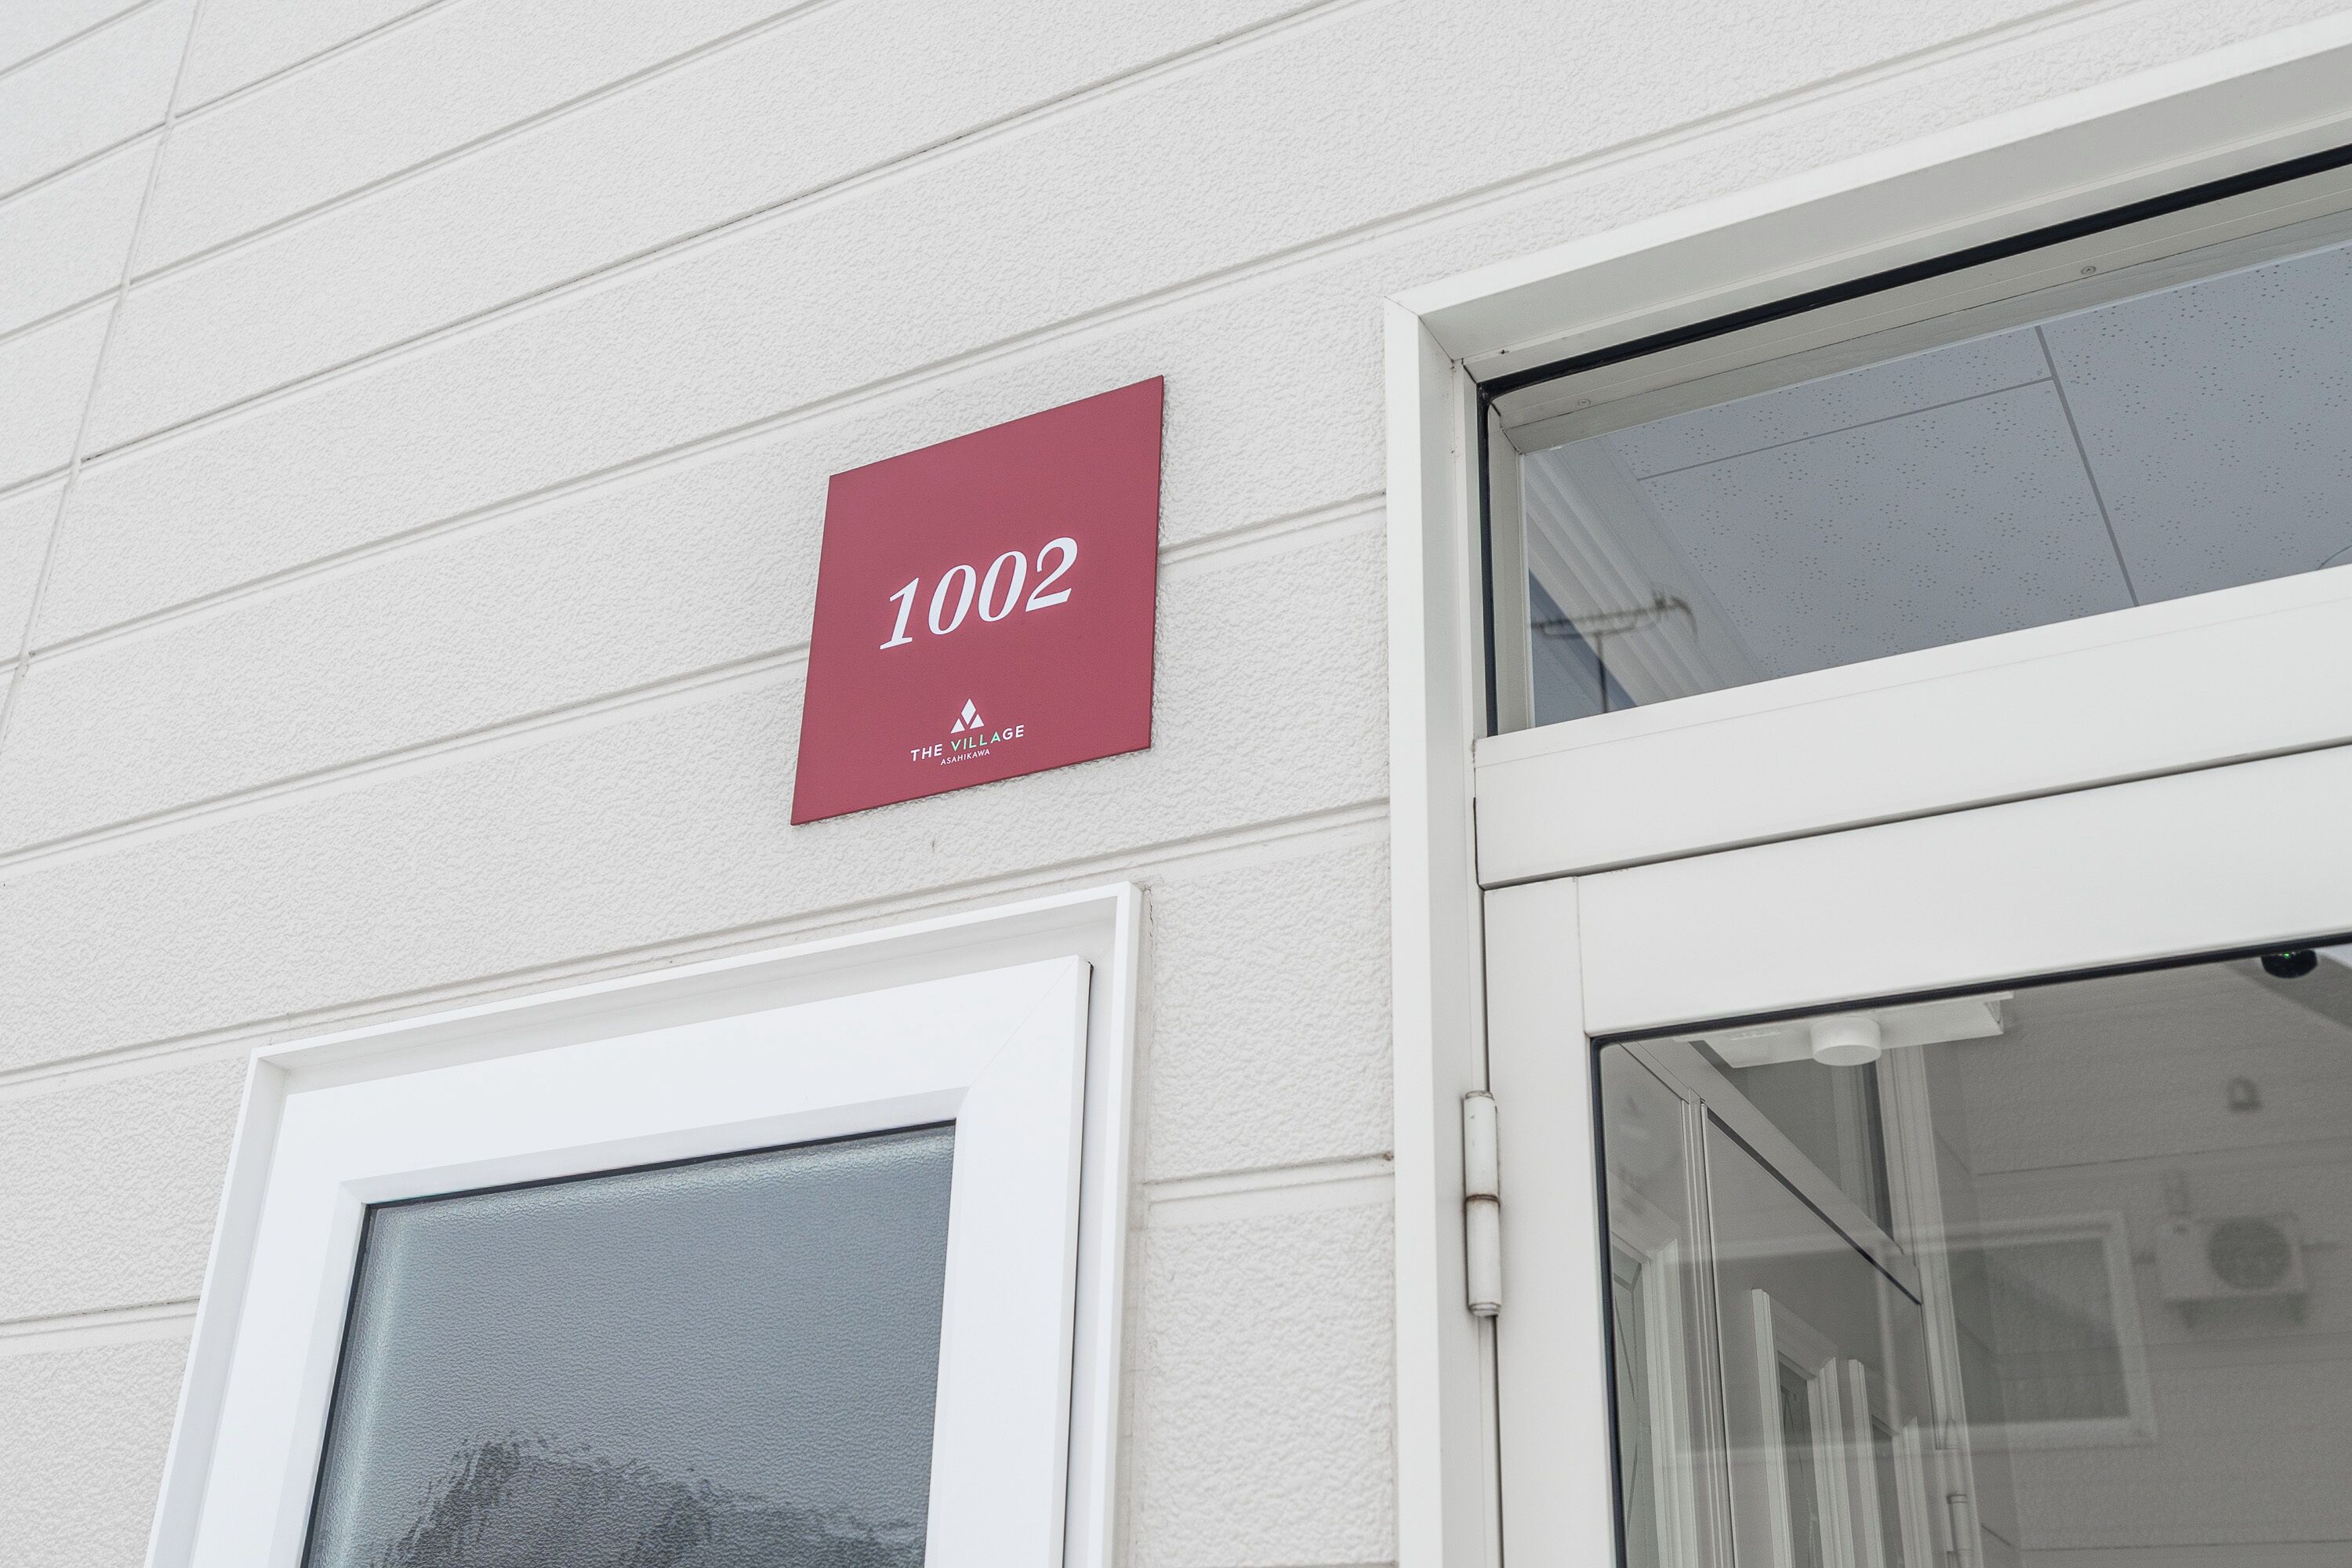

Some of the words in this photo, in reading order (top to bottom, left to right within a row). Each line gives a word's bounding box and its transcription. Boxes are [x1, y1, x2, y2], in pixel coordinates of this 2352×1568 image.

[879, 536, 1078, 650] 1002
[910, 743, 943, 762] THE
[950, 724, 1025, 752] VILLAGE
[940, 748, 990, 766] ASAHIKAWA
